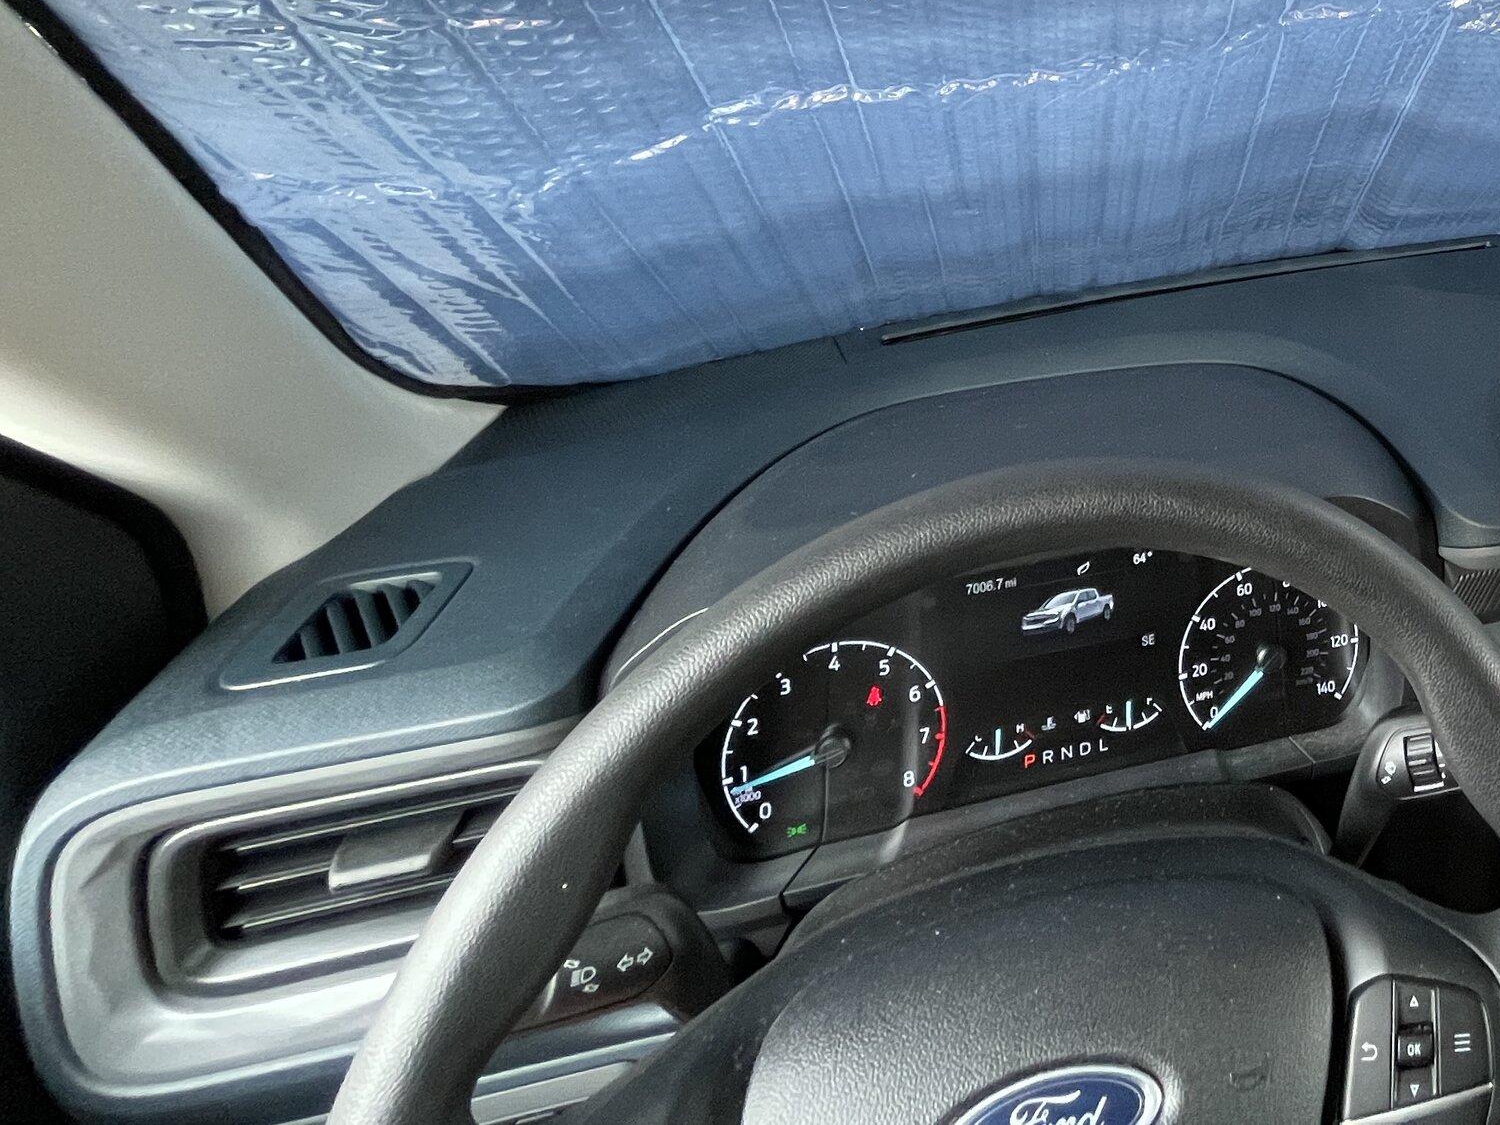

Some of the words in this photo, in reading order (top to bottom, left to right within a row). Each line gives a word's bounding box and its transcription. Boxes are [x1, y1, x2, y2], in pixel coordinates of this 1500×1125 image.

[1132, 551, 1153, 565] 64°
[1236, 582, 1253, 597] 60
[1200, 618, 1216, 631] 40
[1141, 633, 1155, 647] SE
[1329, 633, 1348, 649] 120
[828, 656, 841, 671] 4
[878, 659, 891, 676] 5
[1192, 663, 1208, 678] 20
[780, 678, 791, 696] 3
[909, 685, 921, 702] 6
[1316, 680, 1336, 695] 140
[1195, 690, 1214, 702] MPH
[1209, 706, 1218, 720] 0
[746, 718, 758, 736] 2
[919, 727, 930, 744] 7
[1024, 754, 1036, 769] P
[1042, 749, 1054, 765] R
[1060, 745, 1073, 760] N
[1079, 742, 1091, 755] D
[1099, 739, 1109, 753] L
[740, 765, 747, 782] 1
[903, 770, 915, 787] 8
[759, 802, 772, 819] 0
[1407, 1043, 1421, 1056] OK
[1009, 1089, 1108, 1125] Frd
